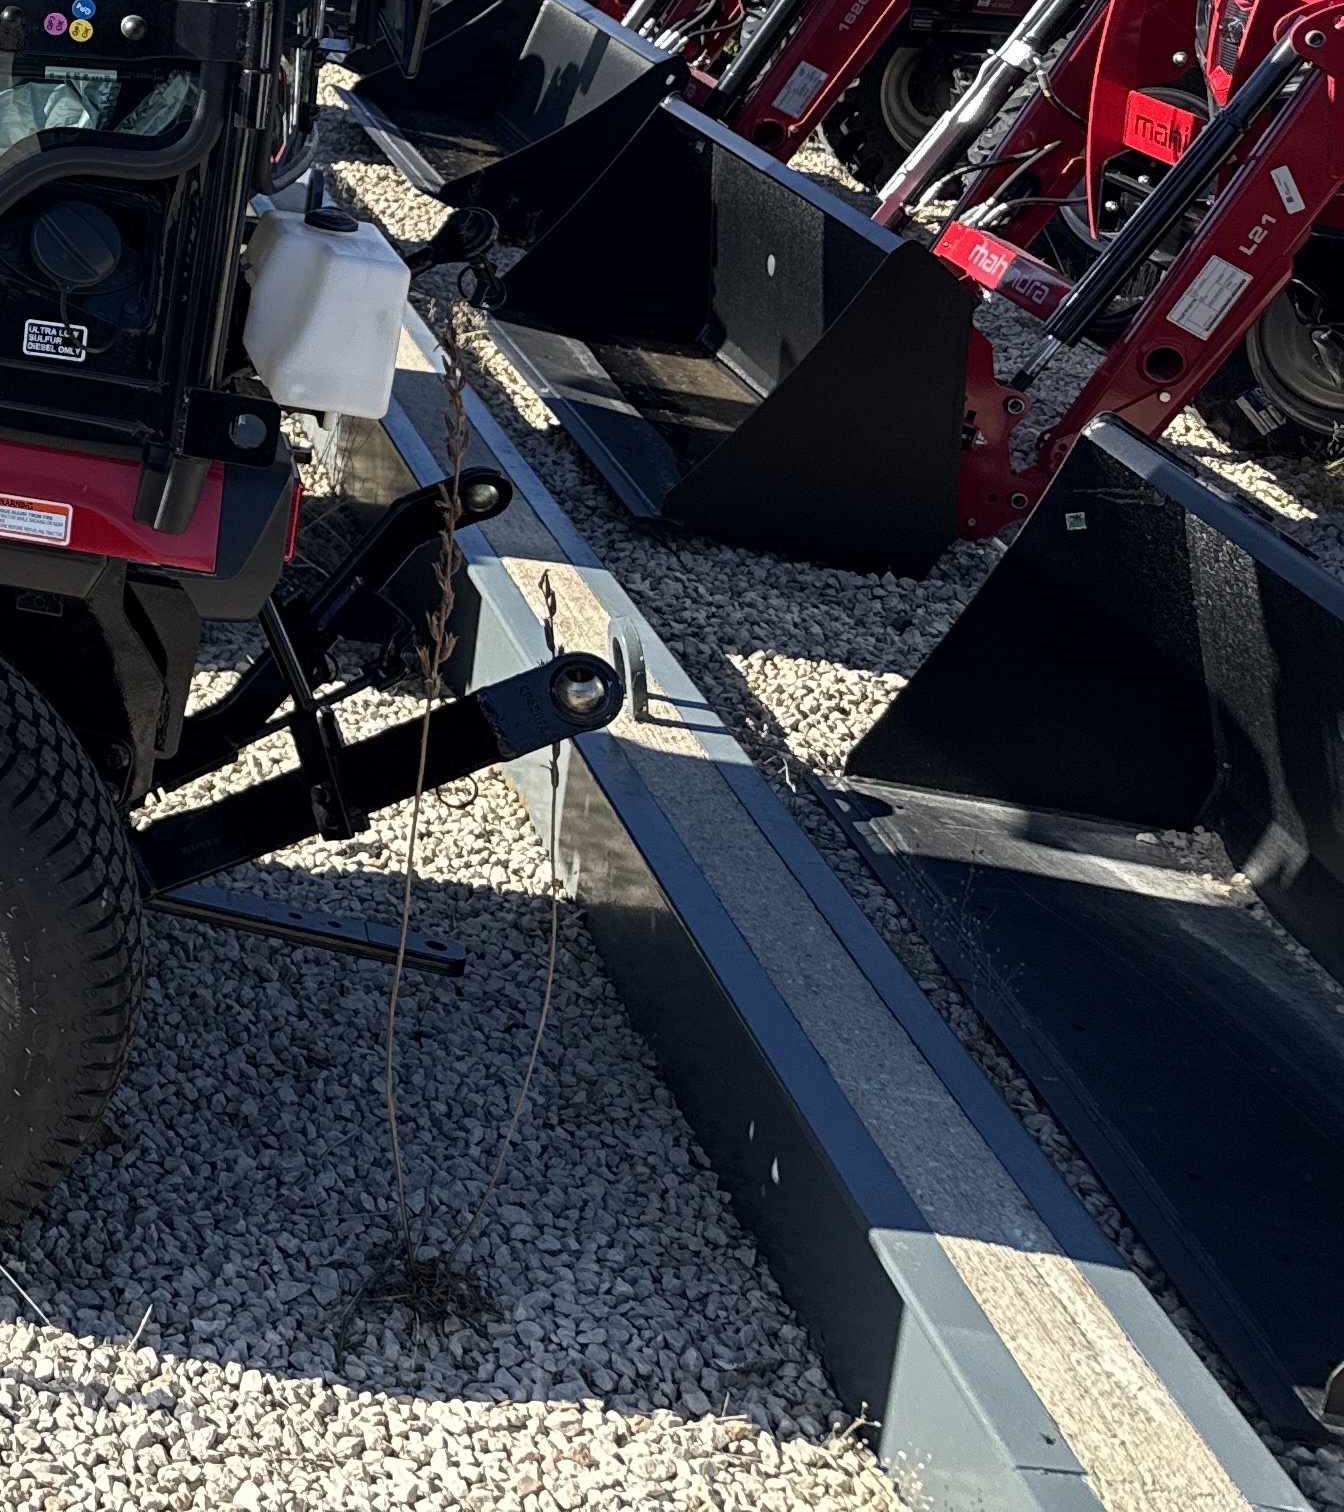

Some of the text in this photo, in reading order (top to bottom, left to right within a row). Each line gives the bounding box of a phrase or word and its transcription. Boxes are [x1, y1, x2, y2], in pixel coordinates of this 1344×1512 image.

[1238, 214, 1276, 255] L21
[29, 325, 57, 336] ULTRA
[29, 334, 62, 345] SULFUR
[28, 342, 80, 355] DIESEL ONLY
